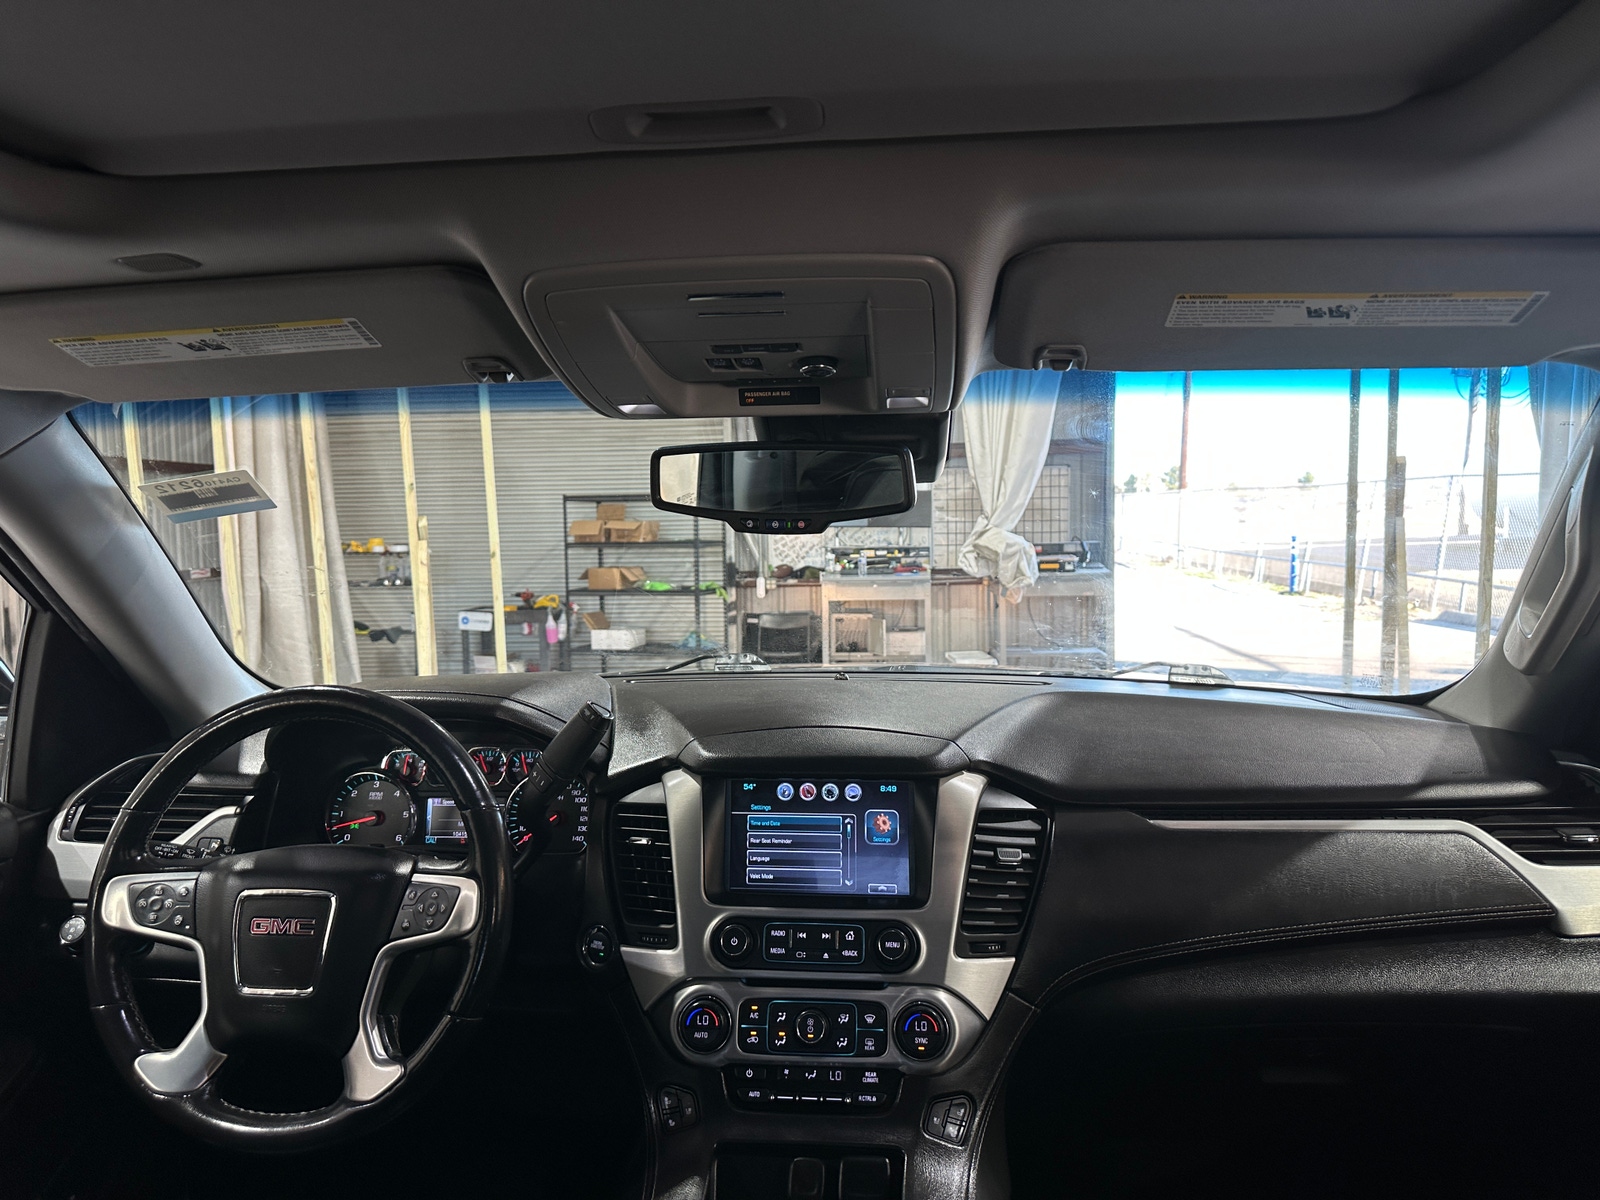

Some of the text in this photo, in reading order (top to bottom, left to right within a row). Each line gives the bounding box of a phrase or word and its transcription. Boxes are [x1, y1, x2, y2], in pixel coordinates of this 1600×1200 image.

[880, 785, 898, 793] 8:49
[750, 803, 772, 811] Settings
[749, 855, 771, 863] Language
[249, 917, 316, 936] GMC
[885, 941, 901, 949] MENU
